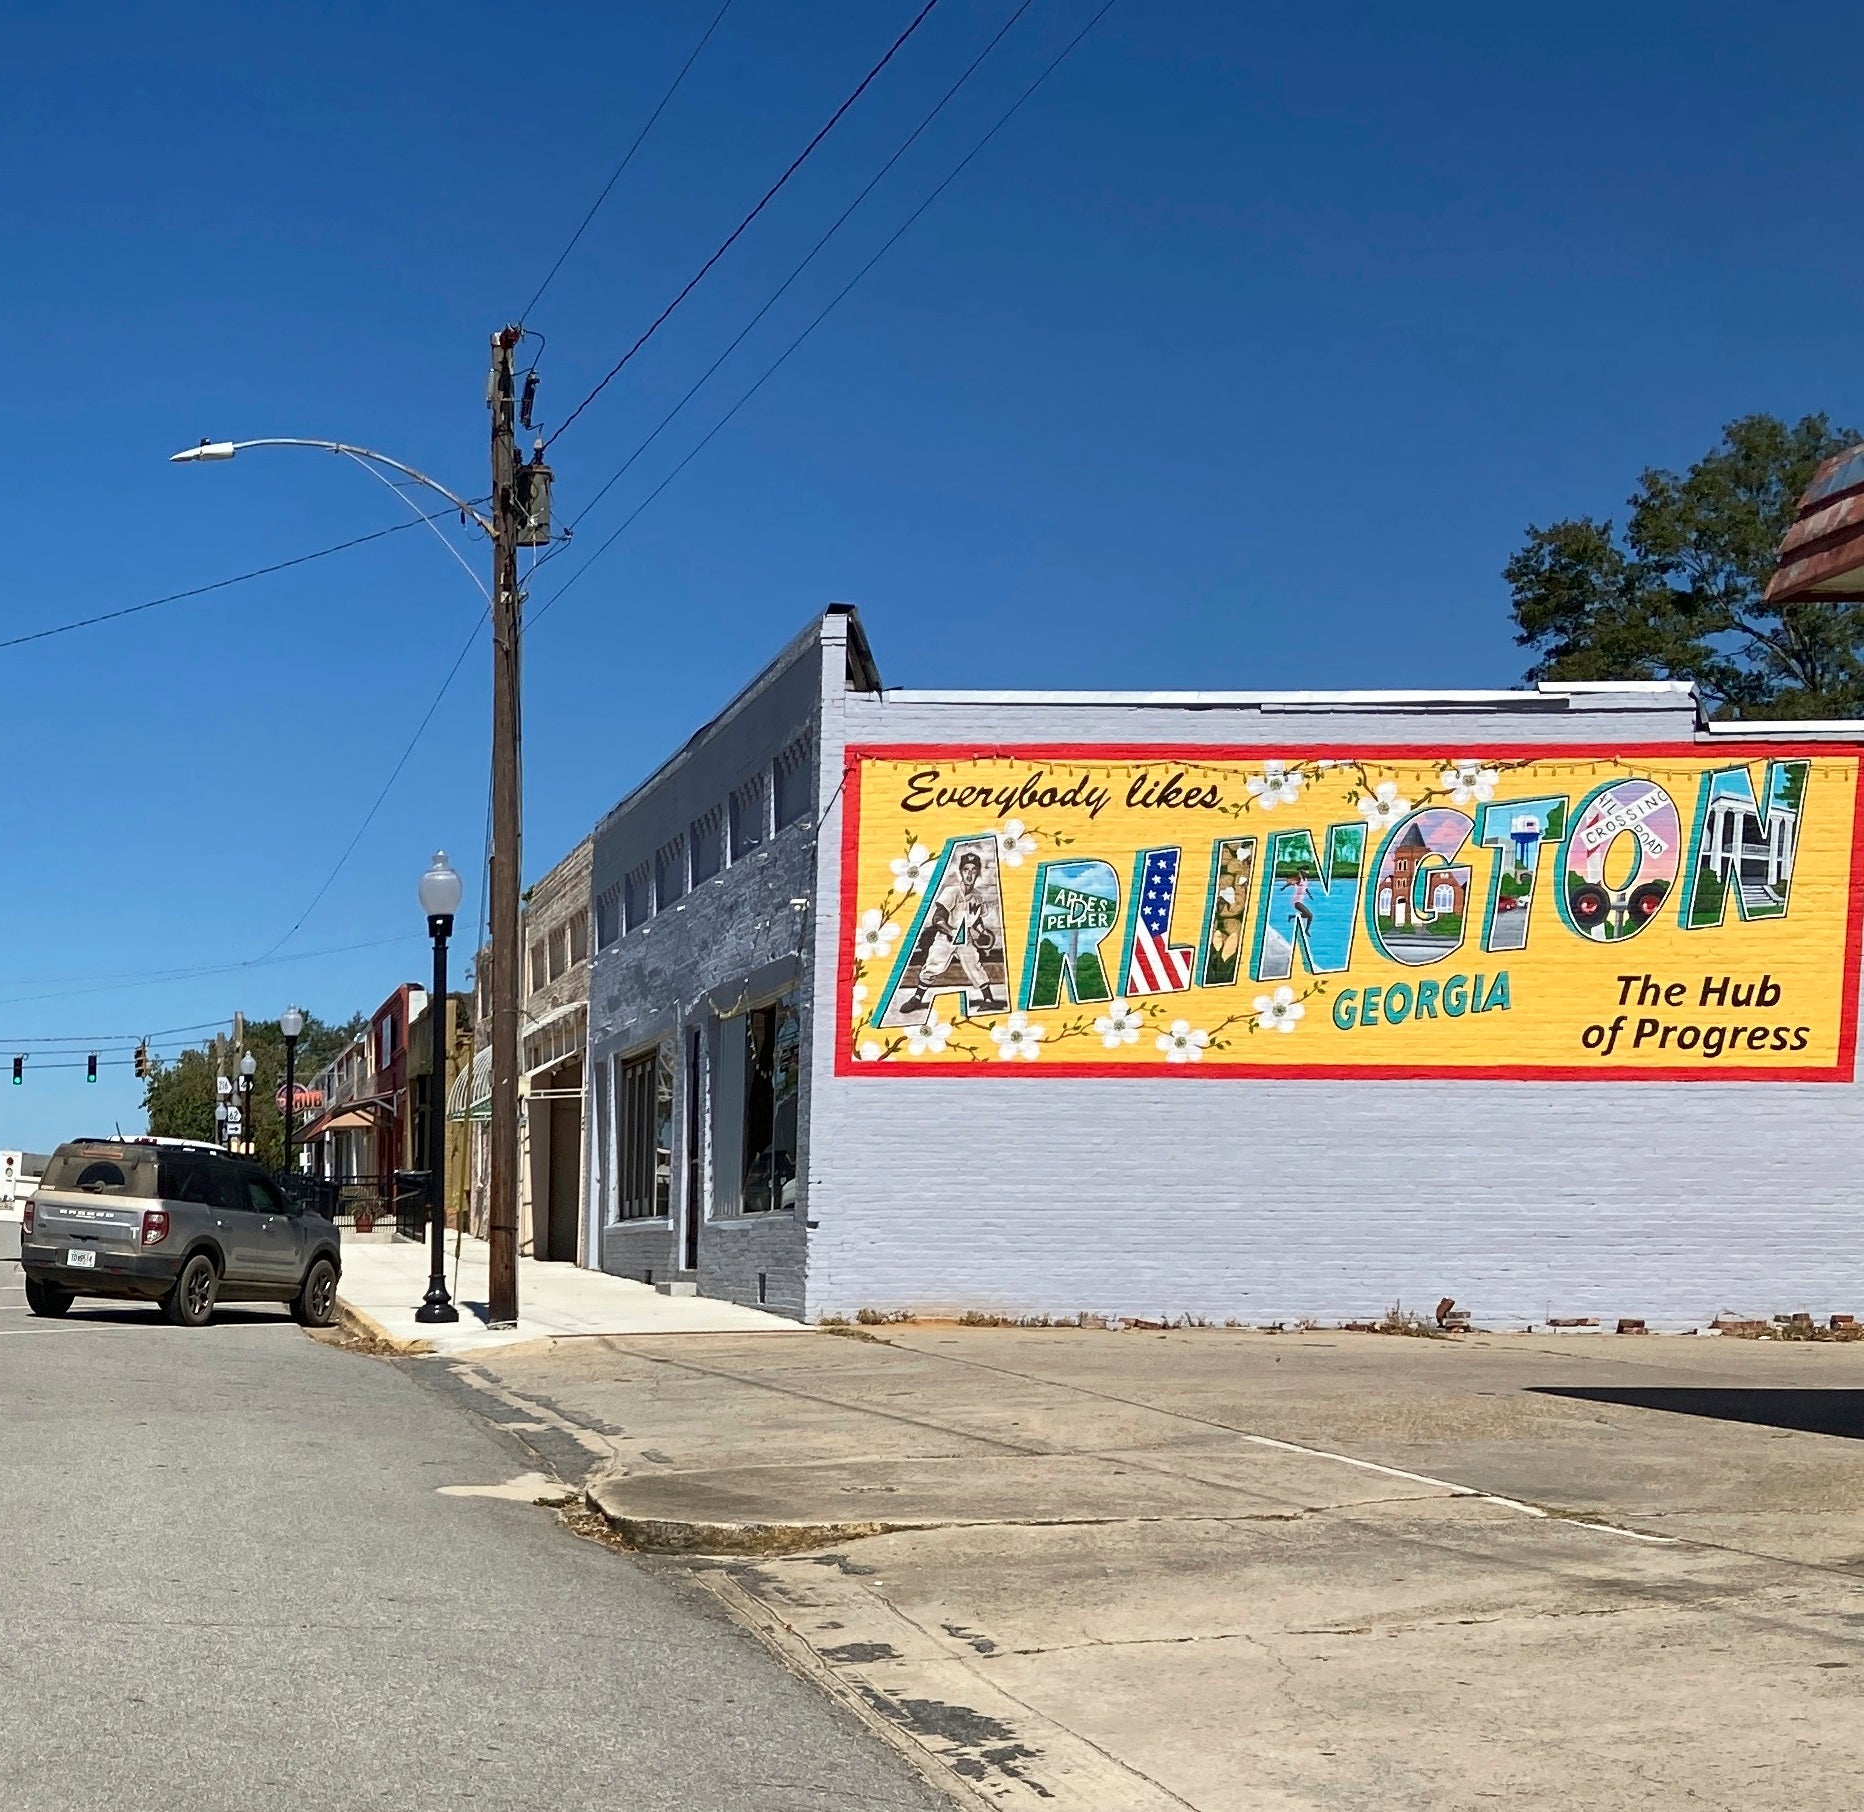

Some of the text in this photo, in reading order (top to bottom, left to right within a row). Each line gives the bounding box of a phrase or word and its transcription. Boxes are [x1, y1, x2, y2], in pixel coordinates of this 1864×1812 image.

[900, 770, 1223, 818] Everybody likes
[1585, 790, 1668, 844] CROSSING
[870, 759, 1811, 1029] ARLINGTON
[1054, 889, 1108, 912] ARES
[1332, 971, 1511, 1031] GEORGIA
[1617, 974, 1781, 1007] The Hub
[1581, 1015, 1811, 1058] of Progress
